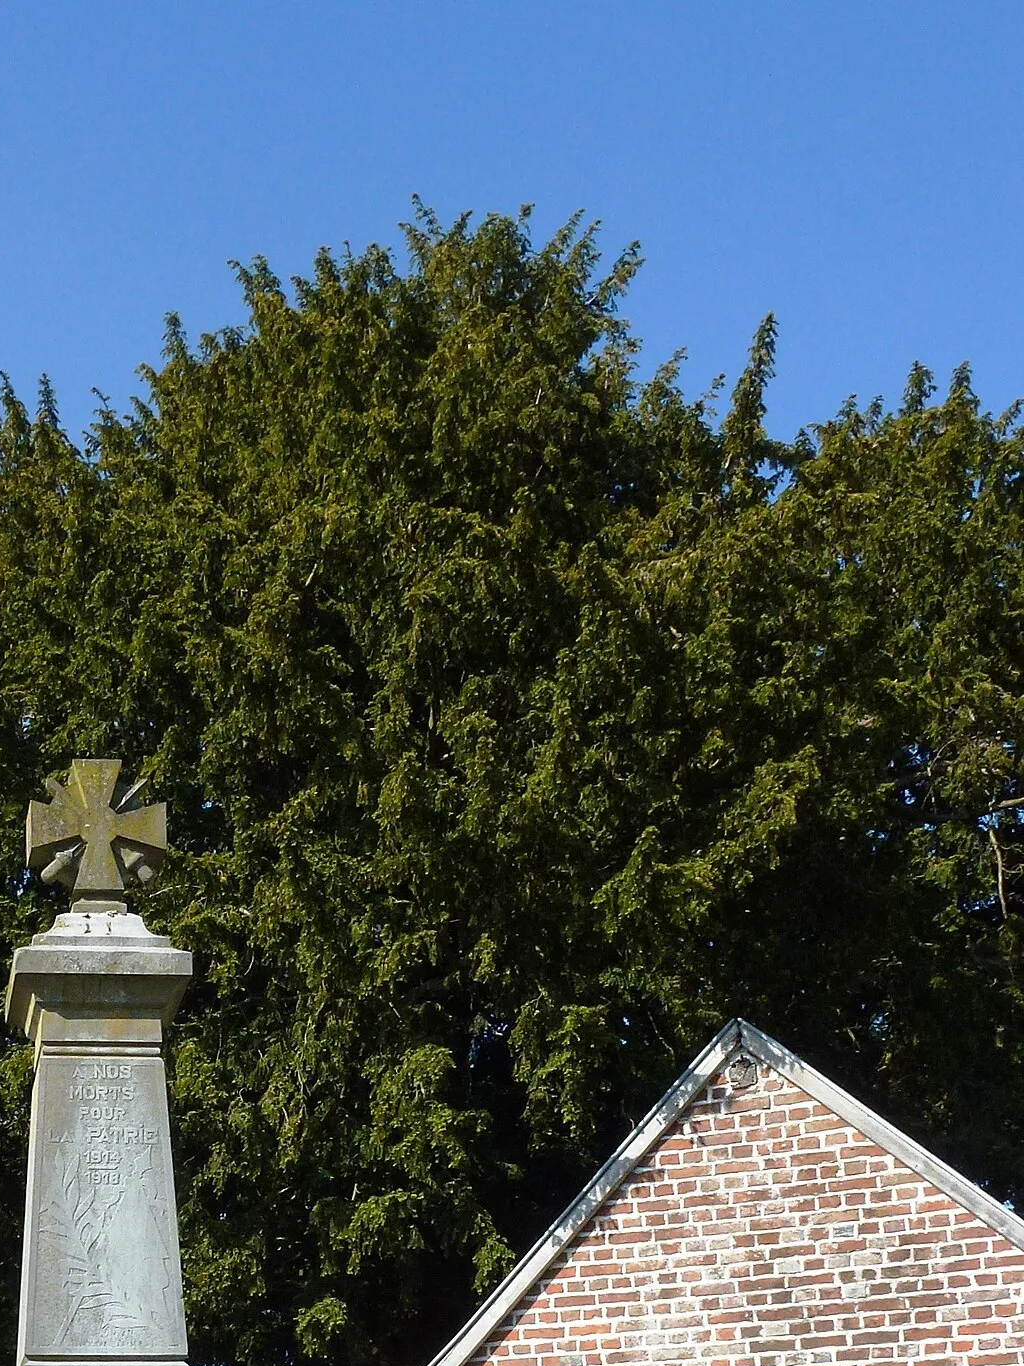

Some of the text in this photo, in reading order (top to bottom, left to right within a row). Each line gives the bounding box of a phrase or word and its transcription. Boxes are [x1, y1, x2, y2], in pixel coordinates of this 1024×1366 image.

[93, 1065, 133, 1080] NOS
[69, 1085, 135, 1101] MORTS
[79, 1106, 127, 1121] POUR
[48, 1127, 160, 1145] LA PATRIE
[83, 1150, 123, 1165] 1914
[84, 1171, 121, 1185] 1918
